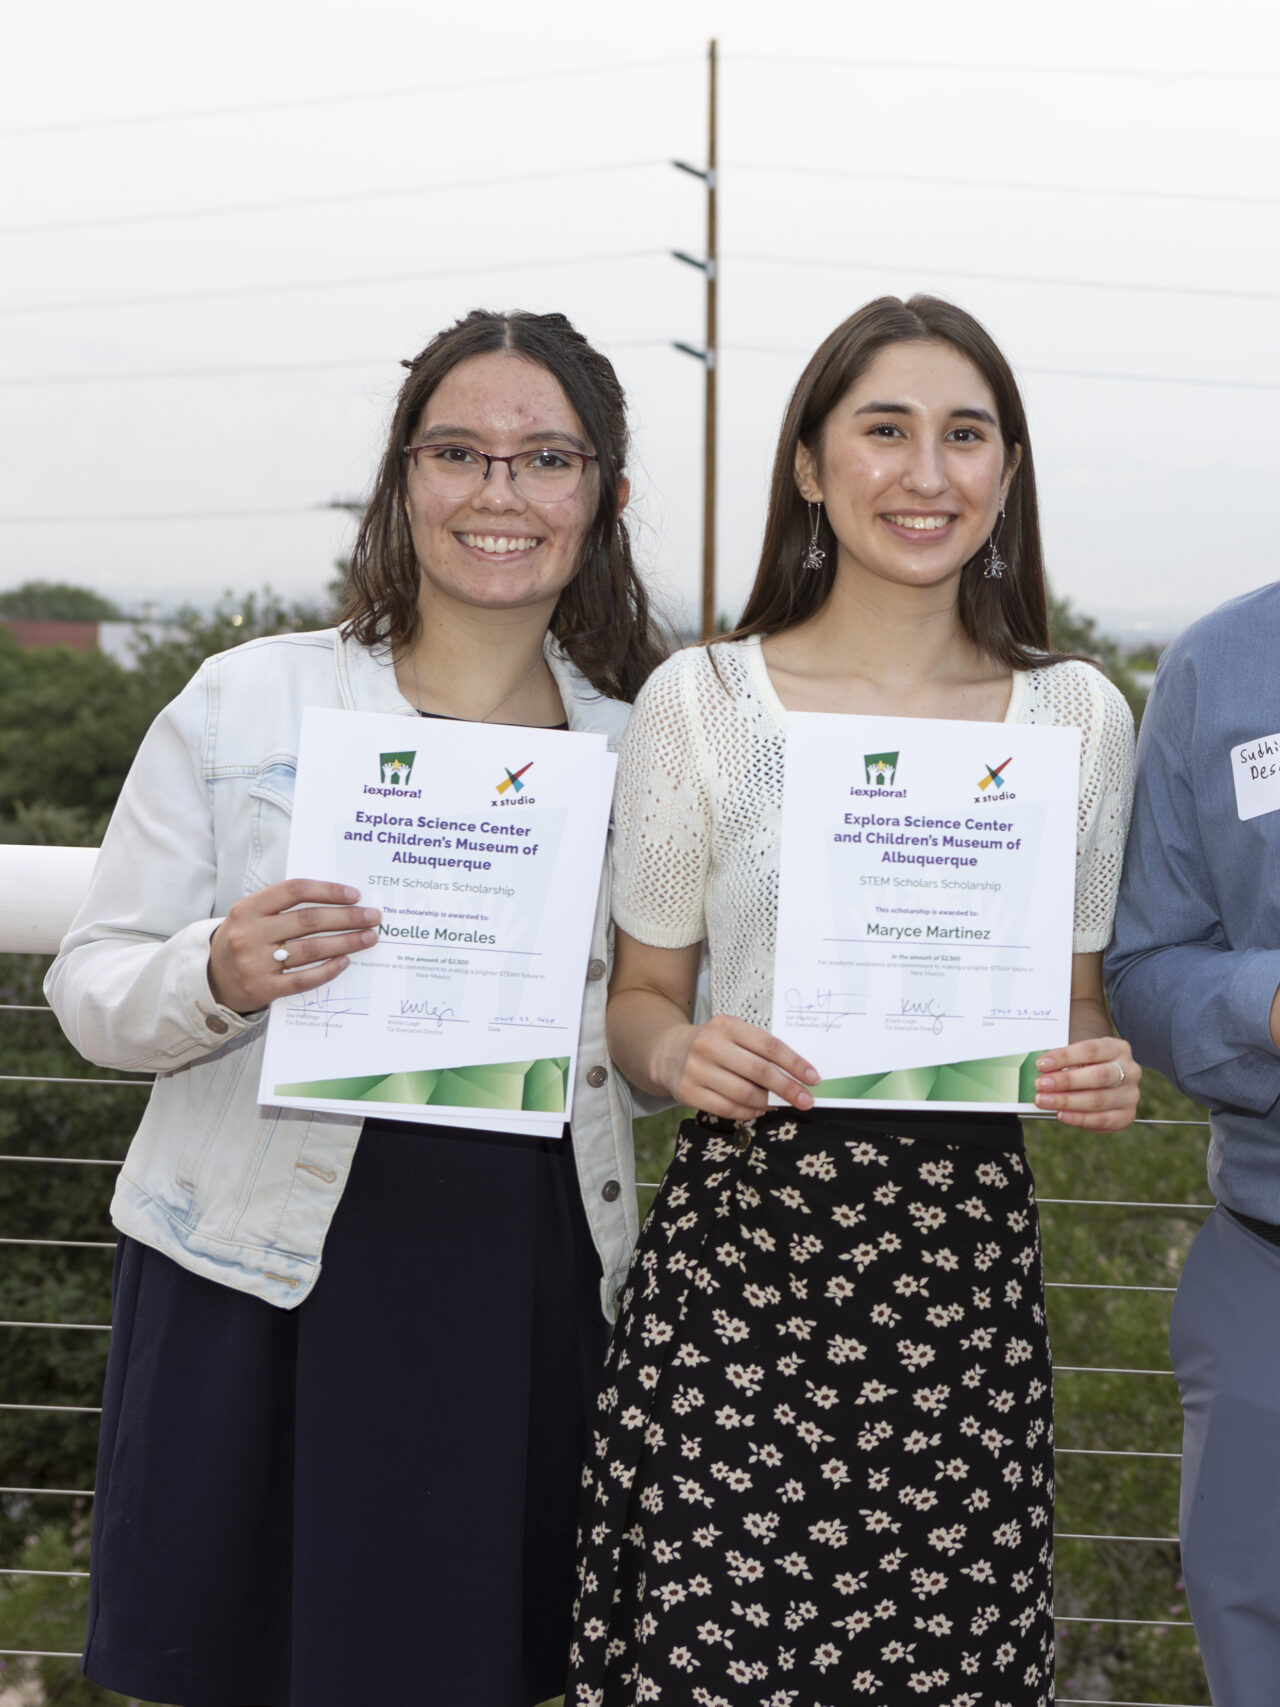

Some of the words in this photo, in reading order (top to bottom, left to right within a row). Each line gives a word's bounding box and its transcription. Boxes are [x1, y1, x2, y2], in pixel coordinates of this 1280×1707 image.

[501, 796, 536, 807] studio
[983, 792, 1016, 803] studio
[356, 811, 413, 828] Explora
[417, 817, 477, 832] Science
[480, 822, 532, 837] Center
[844, 813, 901, 829] Explora
[904, 816, 961, 830] Science
[965, 819, 1014, 832] Center
[344, 830, 373, 842] and
[377, 832, 452, 849] Children’s
[456, 838, 519, 854] Museum
[523, 844, 539, 856] of
[834, 832, 862, 843] and
[866, 832, 939, 847] Children’s
[943, 836, 1003, 850] Museum
[1007, 839, 1022, 850] of
[392, 851, 492, 872] Albuquerque
[882, 851, 978, 869] Albuquerque
[368, 875, 400, 887] STEM
[402, 878, 450, 891] Scholars
[452, 882, 515, 898] Scholarship
[860, 876, 891, 887] STEM
[892, 877, 939, 889] Scholars
[941, 879, 1002, 893] Scholarship
[383, 906, 397, 914] This
[398, 908, 440, 918] scholarship
[891, 908, 931, 916] scholarship
[378, 924, 430, 939] Noelle
[434, 928, 496, 945] Morales
[867, 923, 922, 940] Maryce
[927, 926, 991, 940] Martinez
